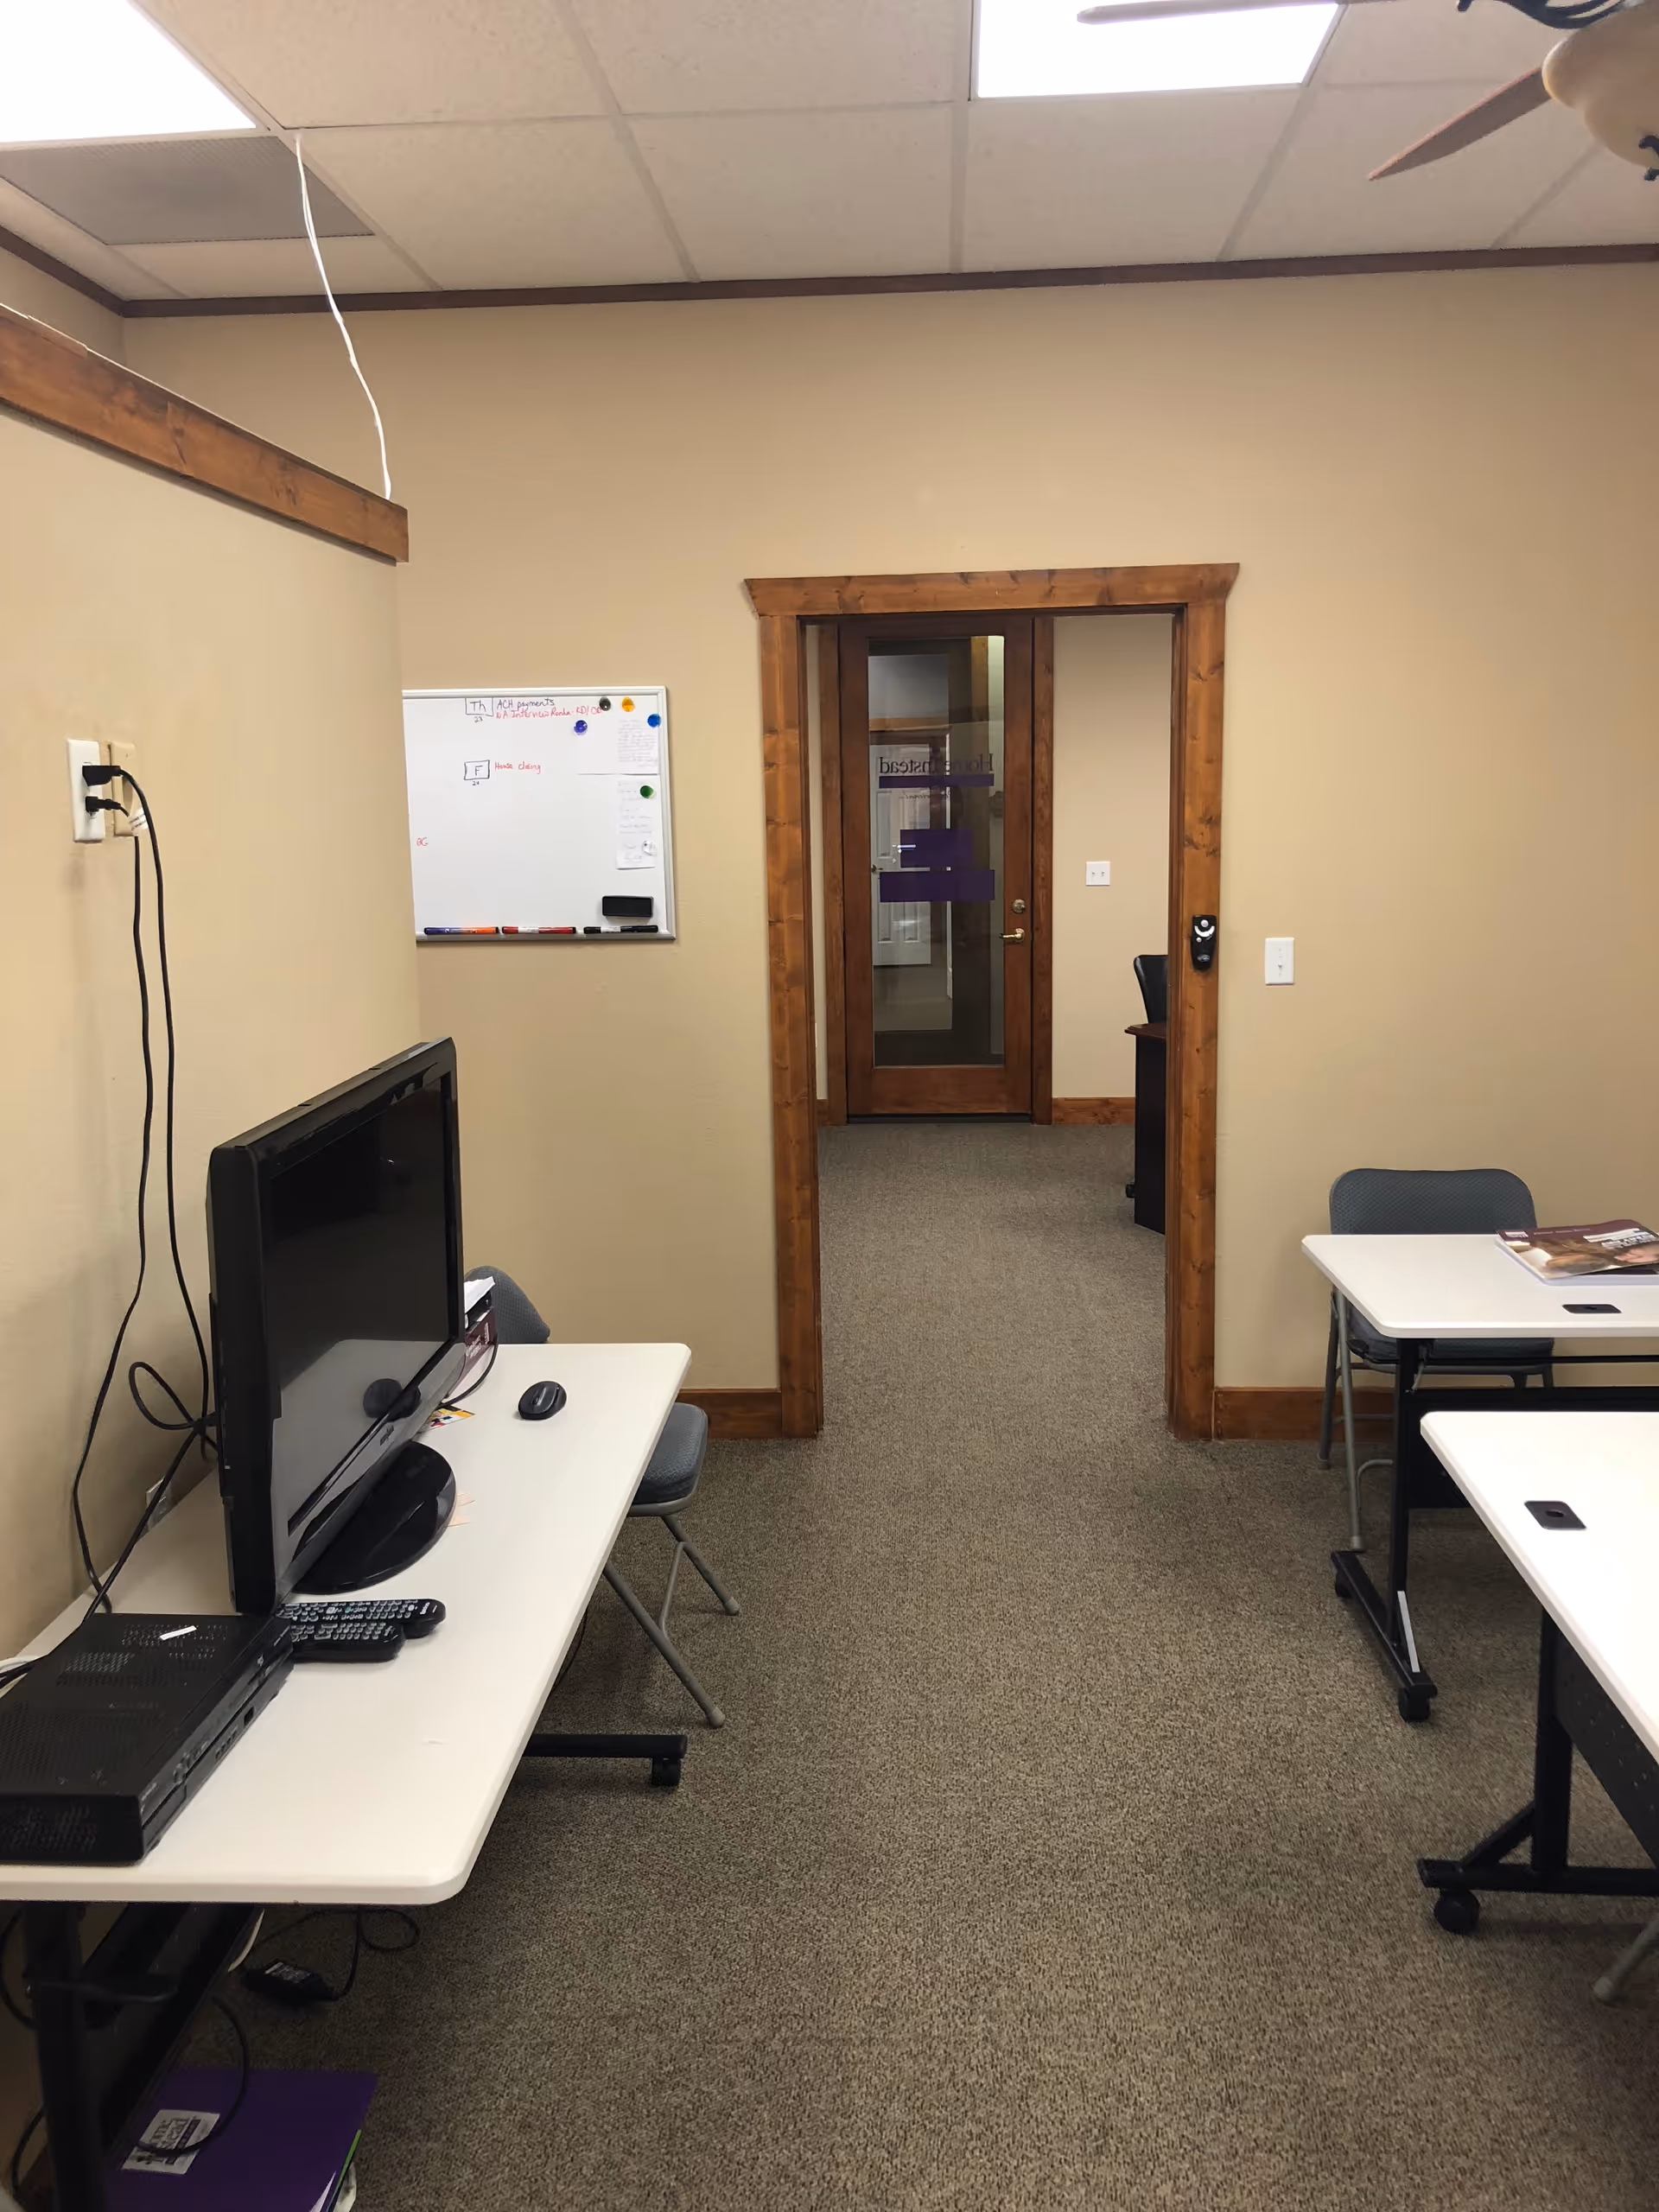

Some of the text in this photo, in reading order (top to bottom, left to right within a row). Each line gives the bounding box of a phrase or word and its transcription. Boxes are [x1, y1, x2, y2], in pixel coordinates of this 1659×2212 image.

[469, 701, 486, 712] Th
[496, 697, 555, 711] ACH payments
[511, 709, 550, 719] Interview
[474, 765, 483, 776] F
[494, 760, 541, 775] House closing
